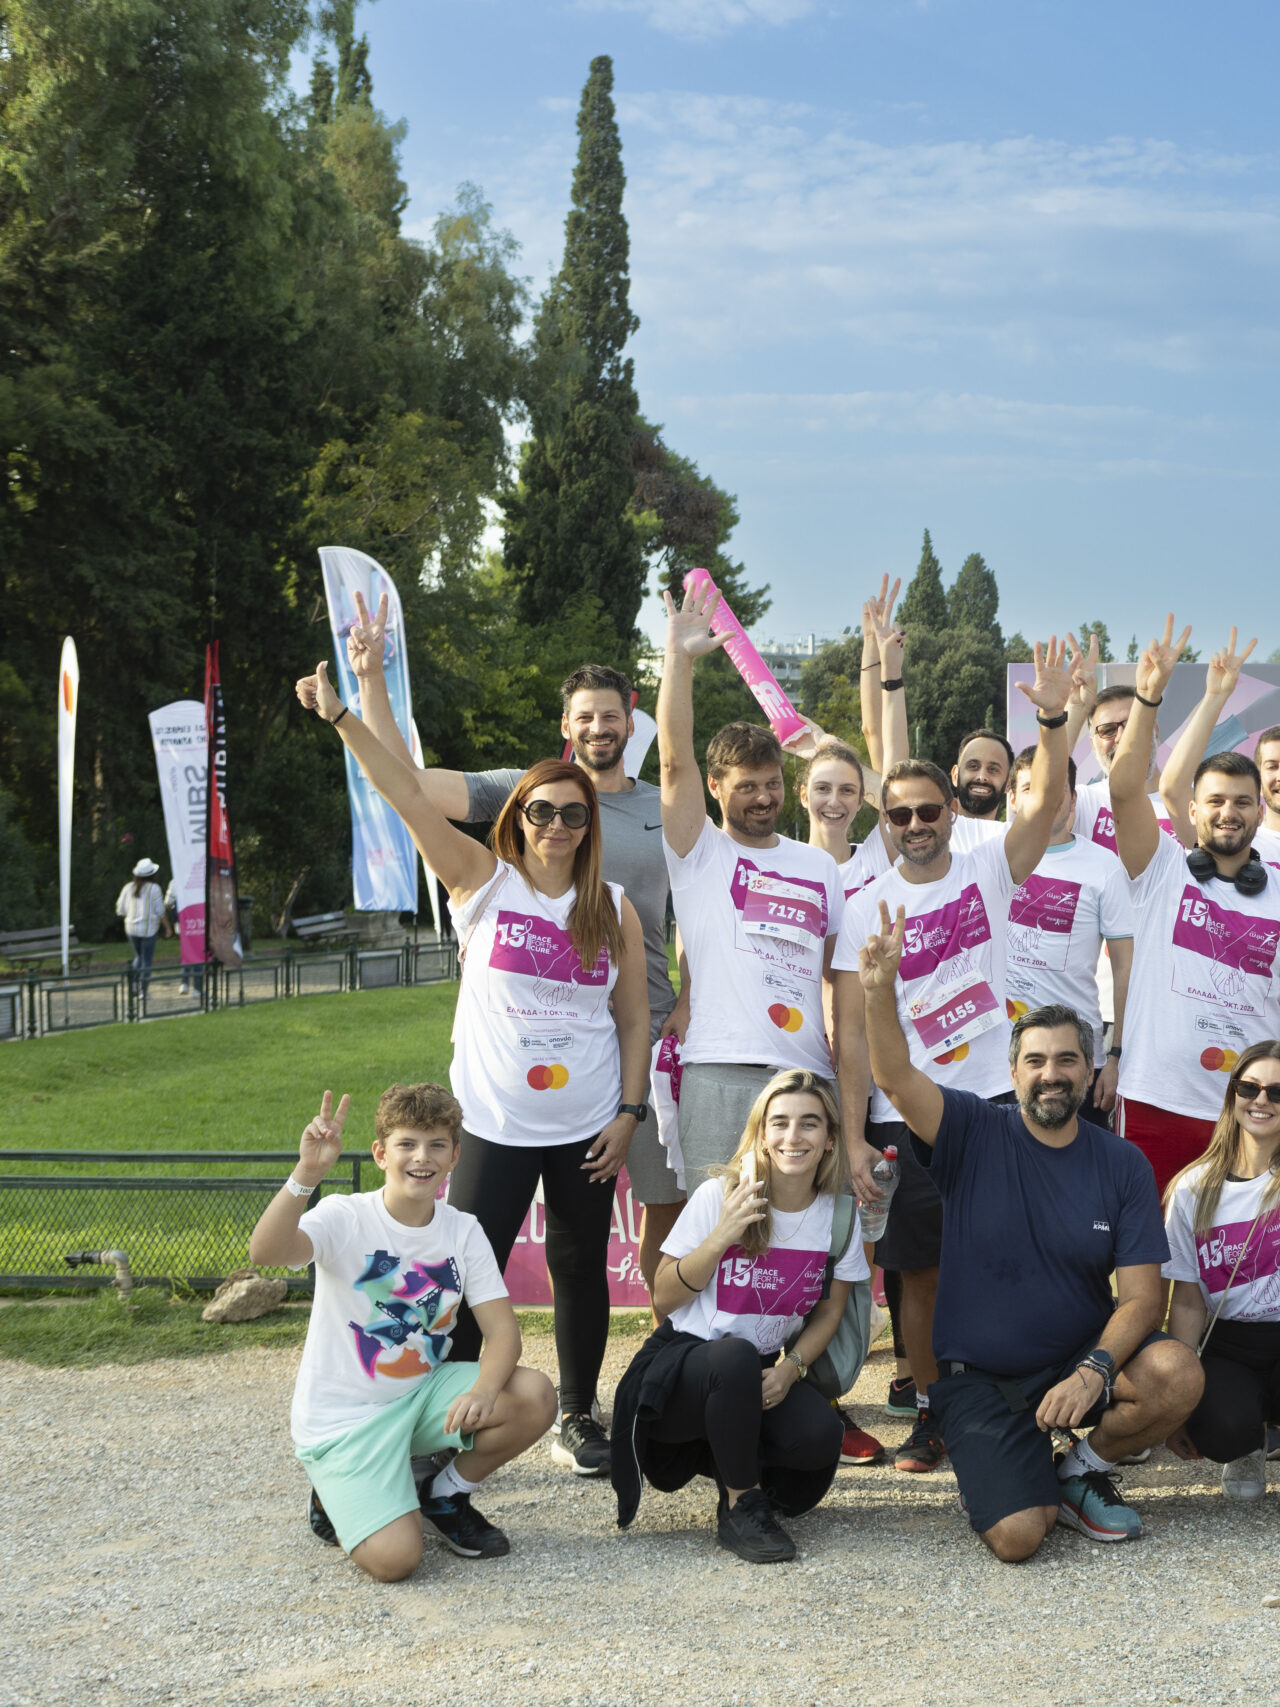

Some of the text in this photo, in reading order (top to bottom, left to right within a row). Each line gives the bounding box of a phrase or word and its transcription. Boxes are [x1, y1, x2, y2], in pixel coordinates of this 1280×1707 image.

[768, 902, 806, 923] 7175
[1180, 898, 1207, 927] 15
[497, 922, 526, 948] 15
[532, 934, 552, 943] RACE
[1187, 986, 1217, 1000] ΕΛΛΑΔΑ
[937, 1000, 976, 1028] 7155
[1199, 1240, 1222, 1269] 15
[722, 1258, 750, 1287] 15
[758, 1269, 778, 1277] RACE
